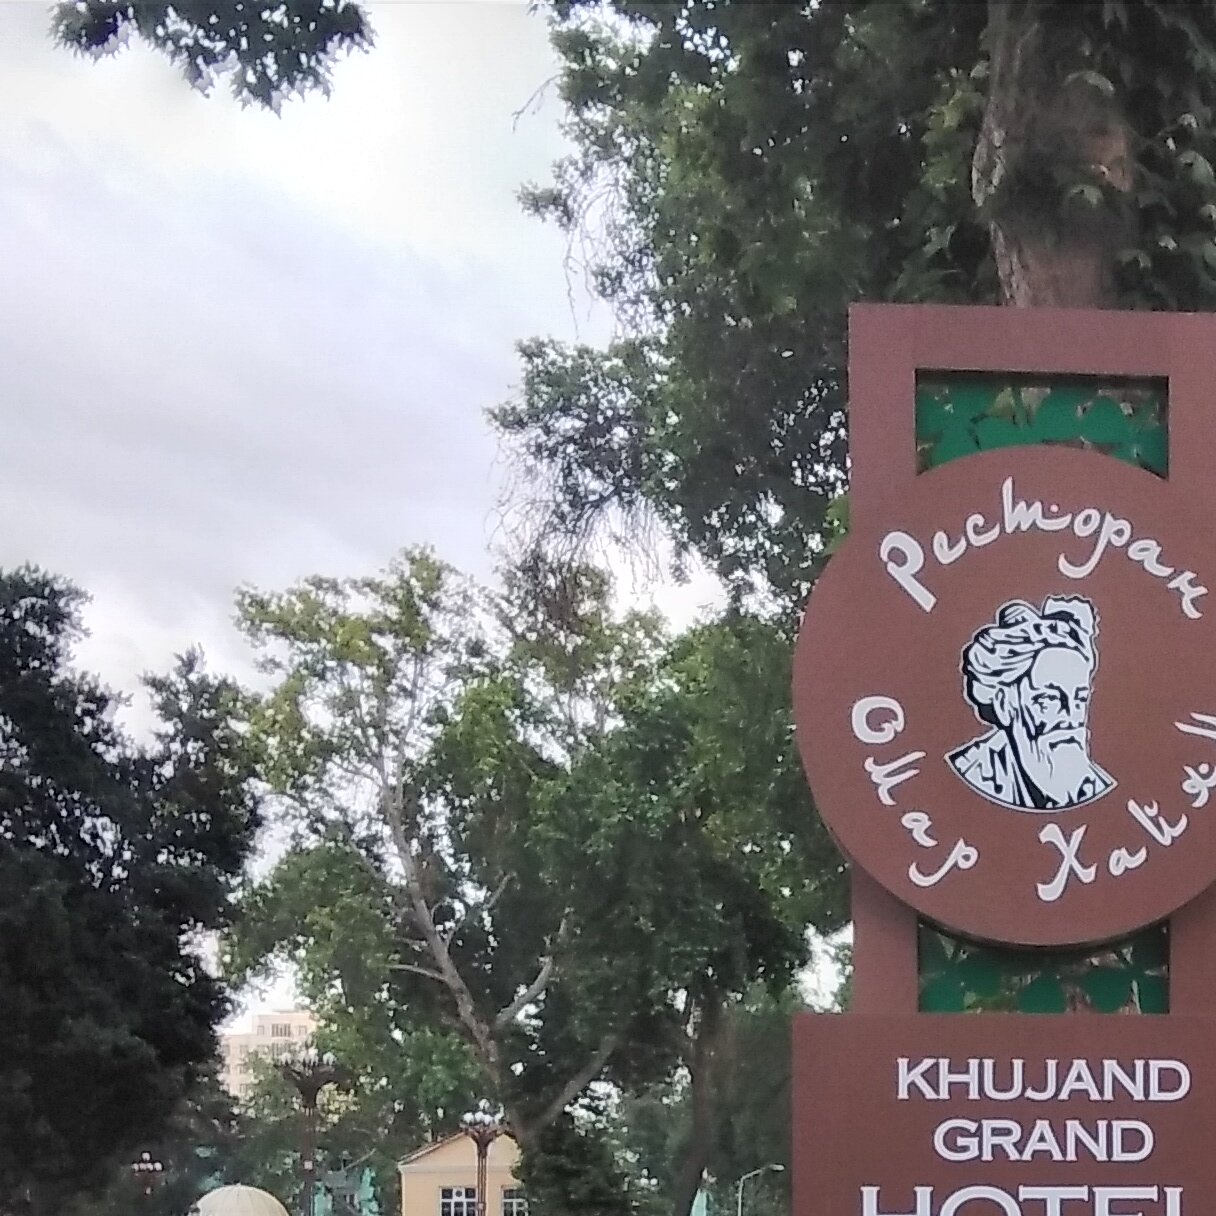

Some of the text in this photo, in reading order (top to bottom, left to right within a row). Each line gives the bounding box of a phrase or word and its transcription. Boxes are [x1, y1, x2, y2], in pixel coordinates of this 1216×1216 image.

[880, 476, 1209, 620] Ресторан
[851, 695, 980, 887] Омар
[896, 1057, 1192, 1101] KHUJAND
[933, 1118, 1155, 1162] GRAND
